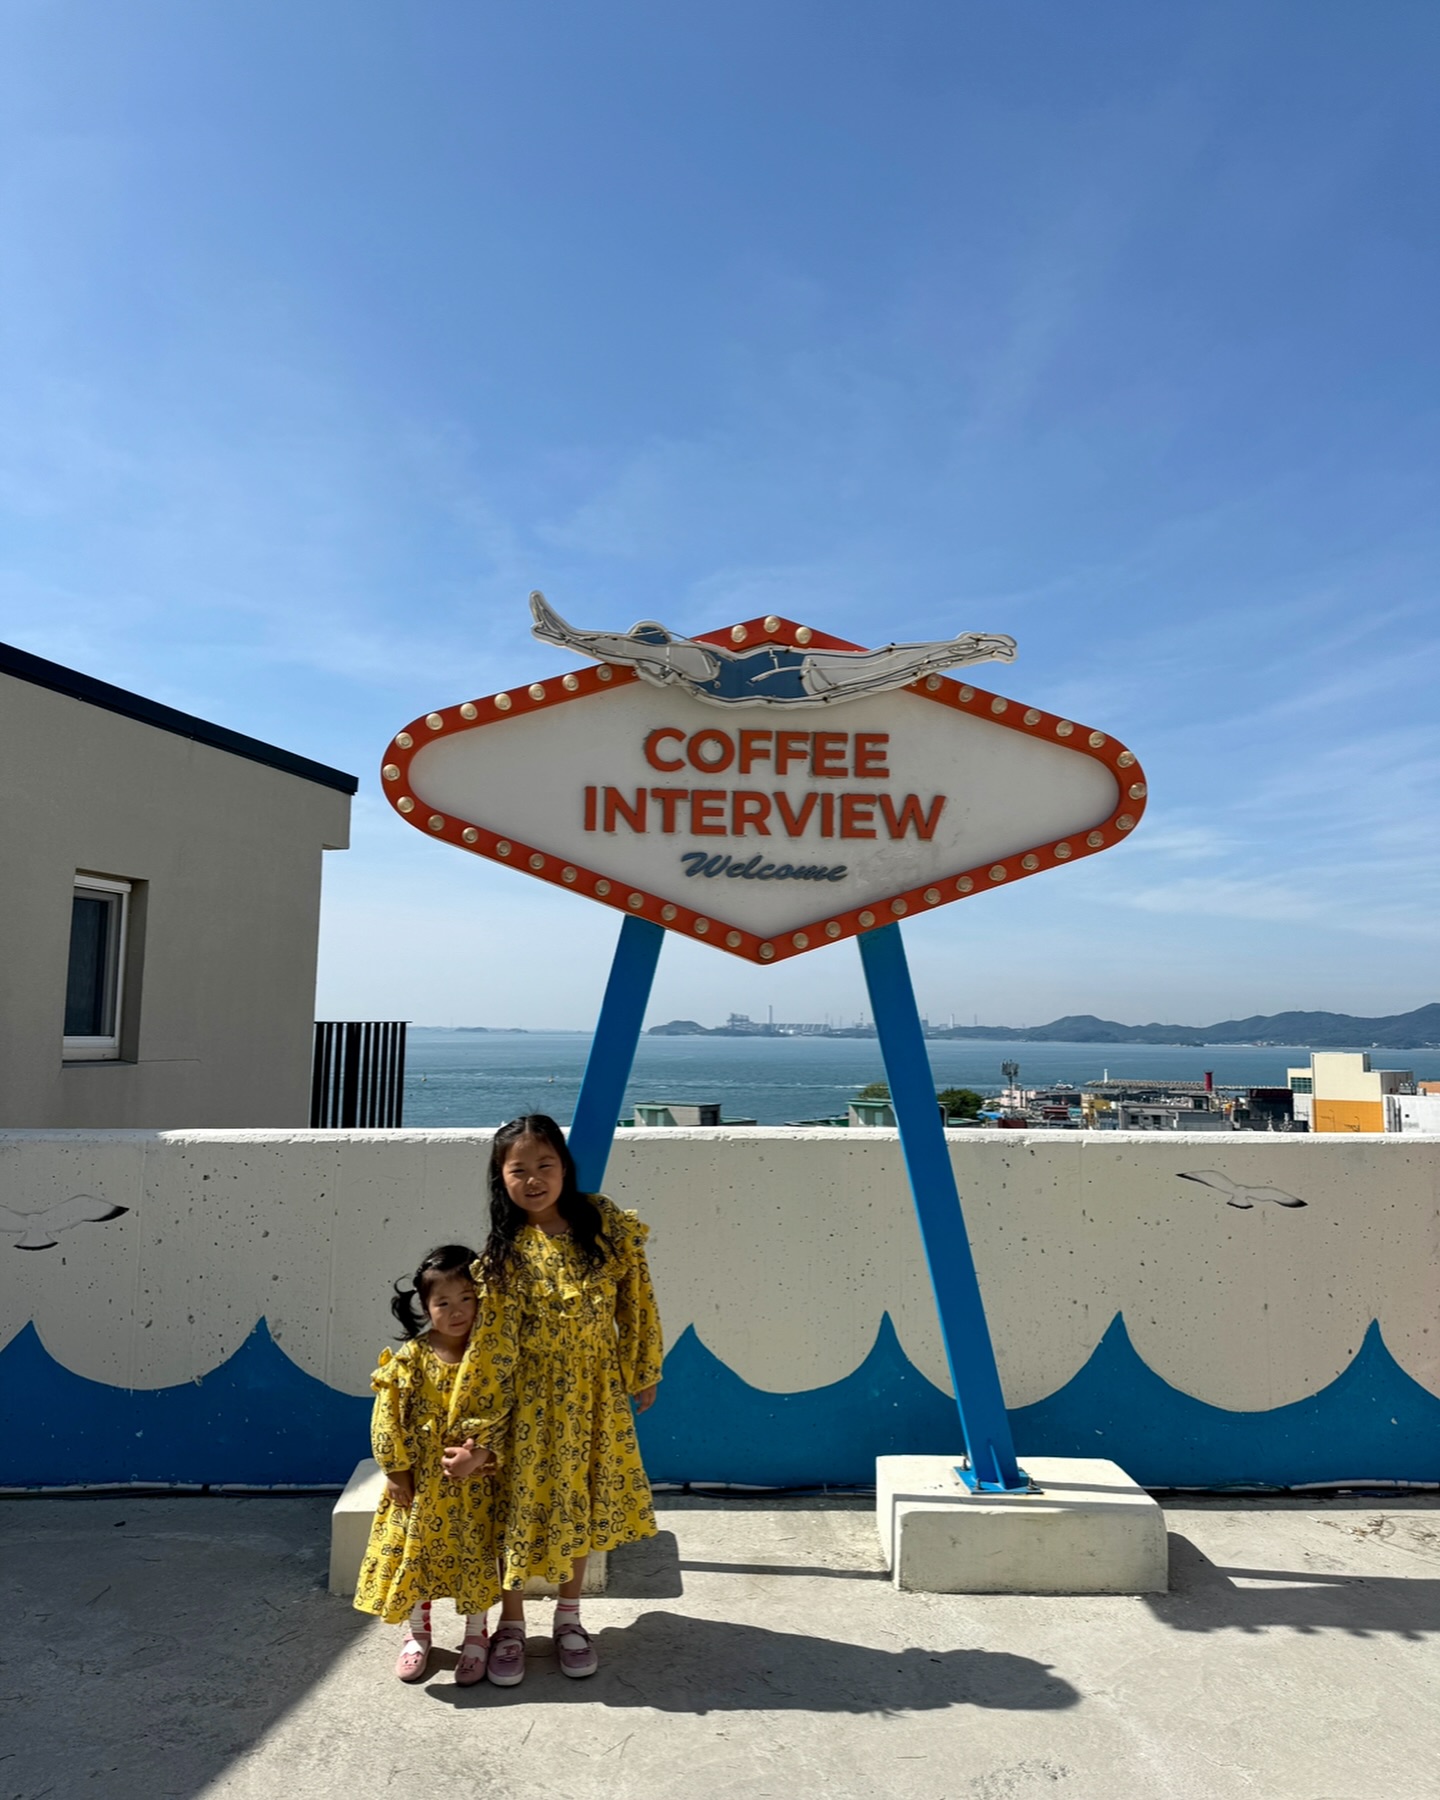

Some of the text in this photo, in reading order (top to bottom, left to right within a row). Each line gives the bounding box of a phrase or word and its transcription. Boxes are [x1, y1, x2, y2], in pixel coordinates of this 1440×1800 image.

[644, 727, 890, 778] COFFEE
[584, 786, 946, 841] INTERVIEW
[681, 852, 848, 882] Welcome
